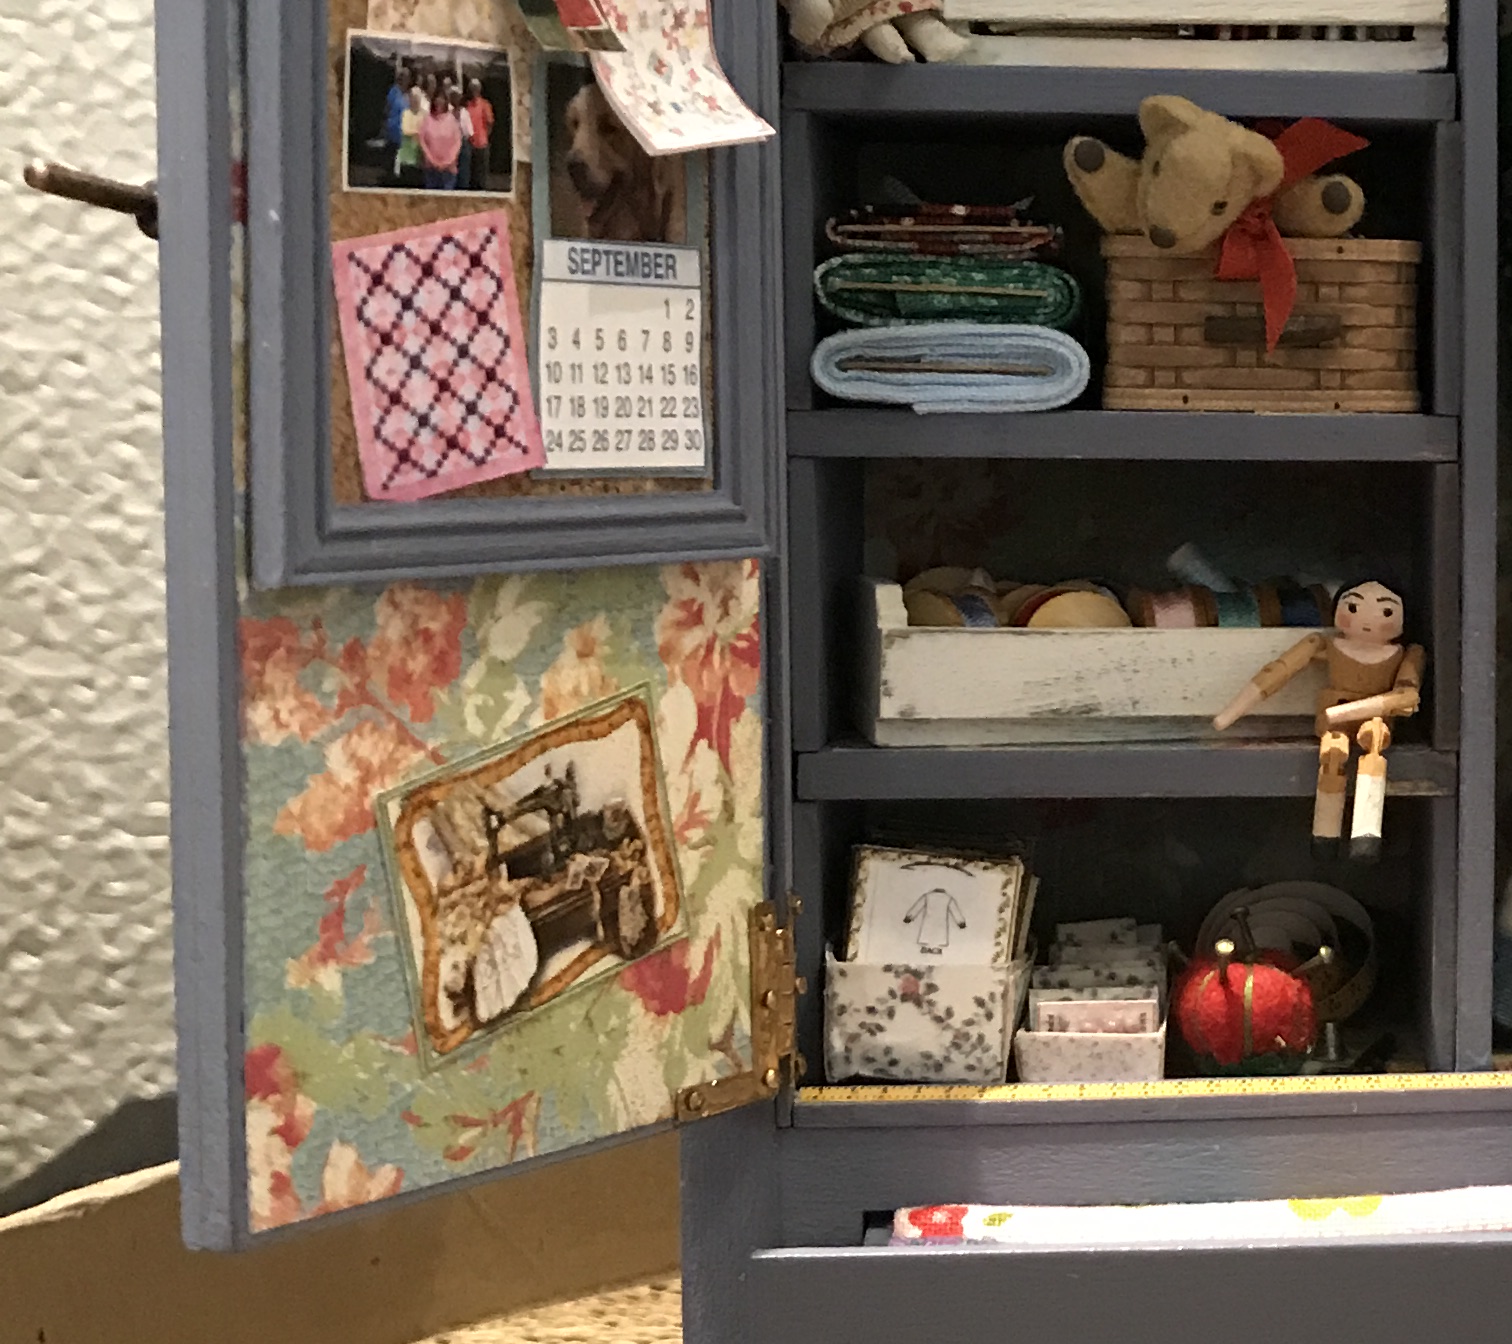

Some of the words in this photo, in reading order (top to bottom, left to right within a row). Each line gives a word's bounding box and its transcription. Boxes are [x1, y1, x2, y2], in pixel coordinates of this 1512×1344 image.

[568, 247, 677, 279] SEPTEMBER
[664, 299, 670, 319] 1
[685, 298, 695, 320] 2
[548, 327, 558, 350] 3
[572, 328, 580, 350] 4
[595, 328, 604, 350] 5
[617, 329, 627, 351] 6
[642, 329, 650, 351] 7
[663, 331, 672, 353] 8
[685, 331, 694, 353] 9
[545, 361, 562, 384] 10
[569, 363, 583, 384] 11
[592, 362, 608, 385] 12
[615, 363, 631, 385] 13
[638, 363, 653, 385] 14
[661, 363, 676, 385] 15
[683, 364, 698, 386] 16
[546, 395, 562, 418] 17
[569, 396, 585, 418] 18
[592, 396, 609, 418] 19
[615, 396, 632, 418] 20
[638, 396, 653, 418] 21
[660, 396, 677, 418] 22
[683, 396, 699, 418] 23
[546, 429, 563, 452] 24
[568, 429, 586, 452] 25
[592, 429, 609, 452] 26
[615, 429, 633, 452] 27
[638, 429, 655, 451] 28
[661, 429, 679, 451] 29
[685, 429, 701, 450] 30
